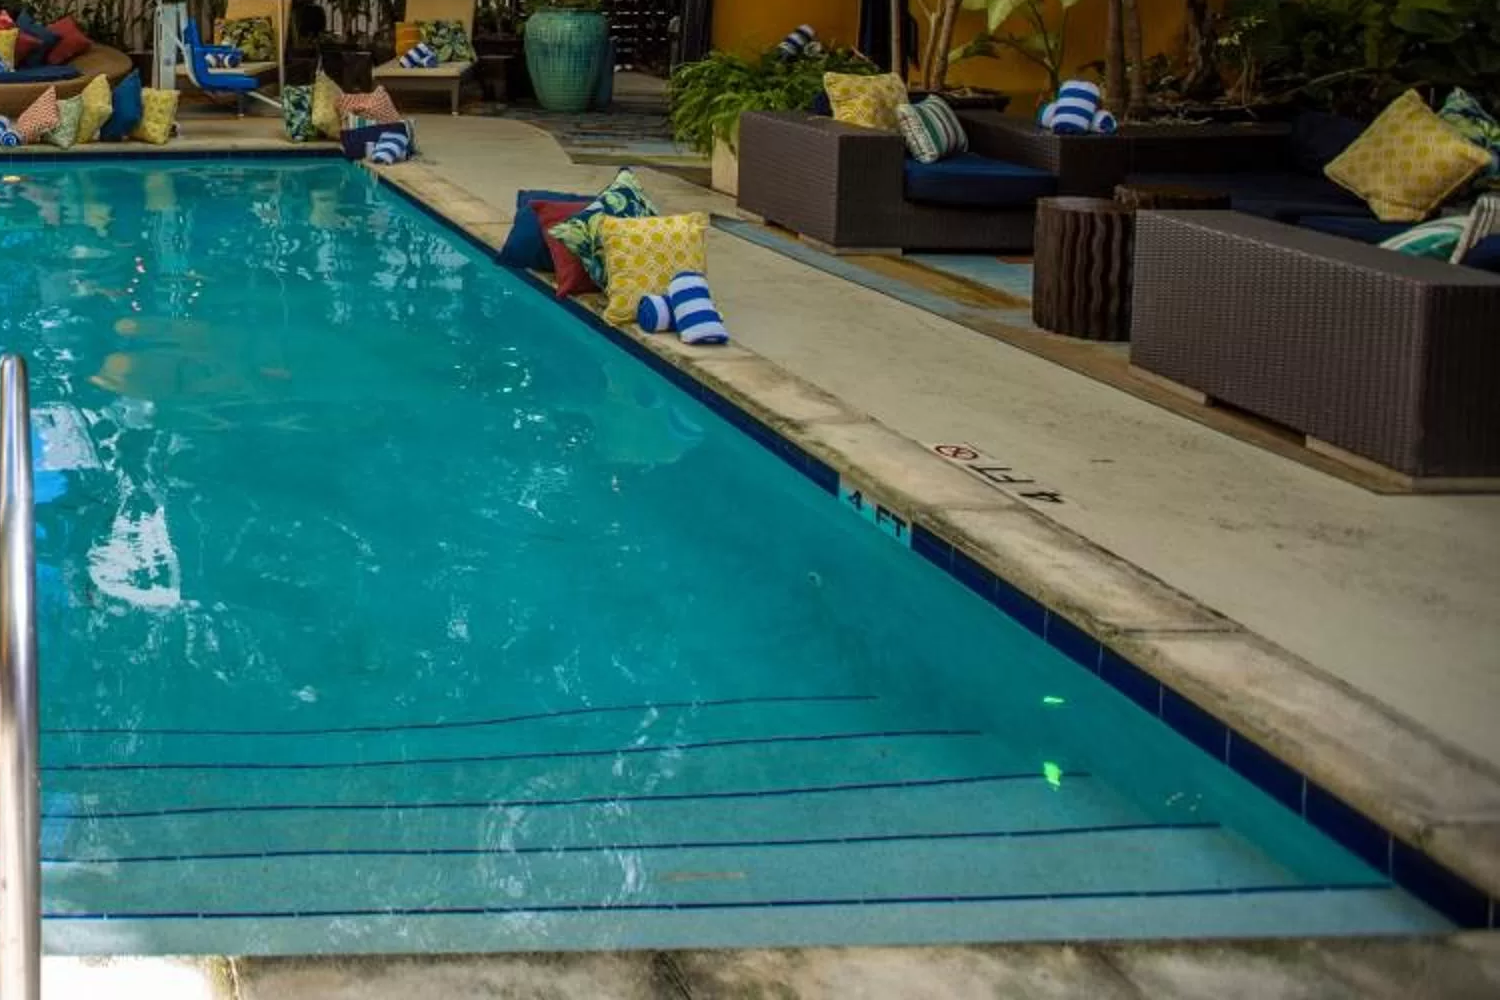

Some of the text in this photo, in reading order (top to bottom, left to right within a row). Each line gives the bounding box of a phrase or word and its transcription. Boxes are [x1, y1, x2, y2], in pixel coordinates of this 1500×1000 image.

[967, 464, 1064, 504] 4 FT
[848, 489, 907, 537] 4 FT
